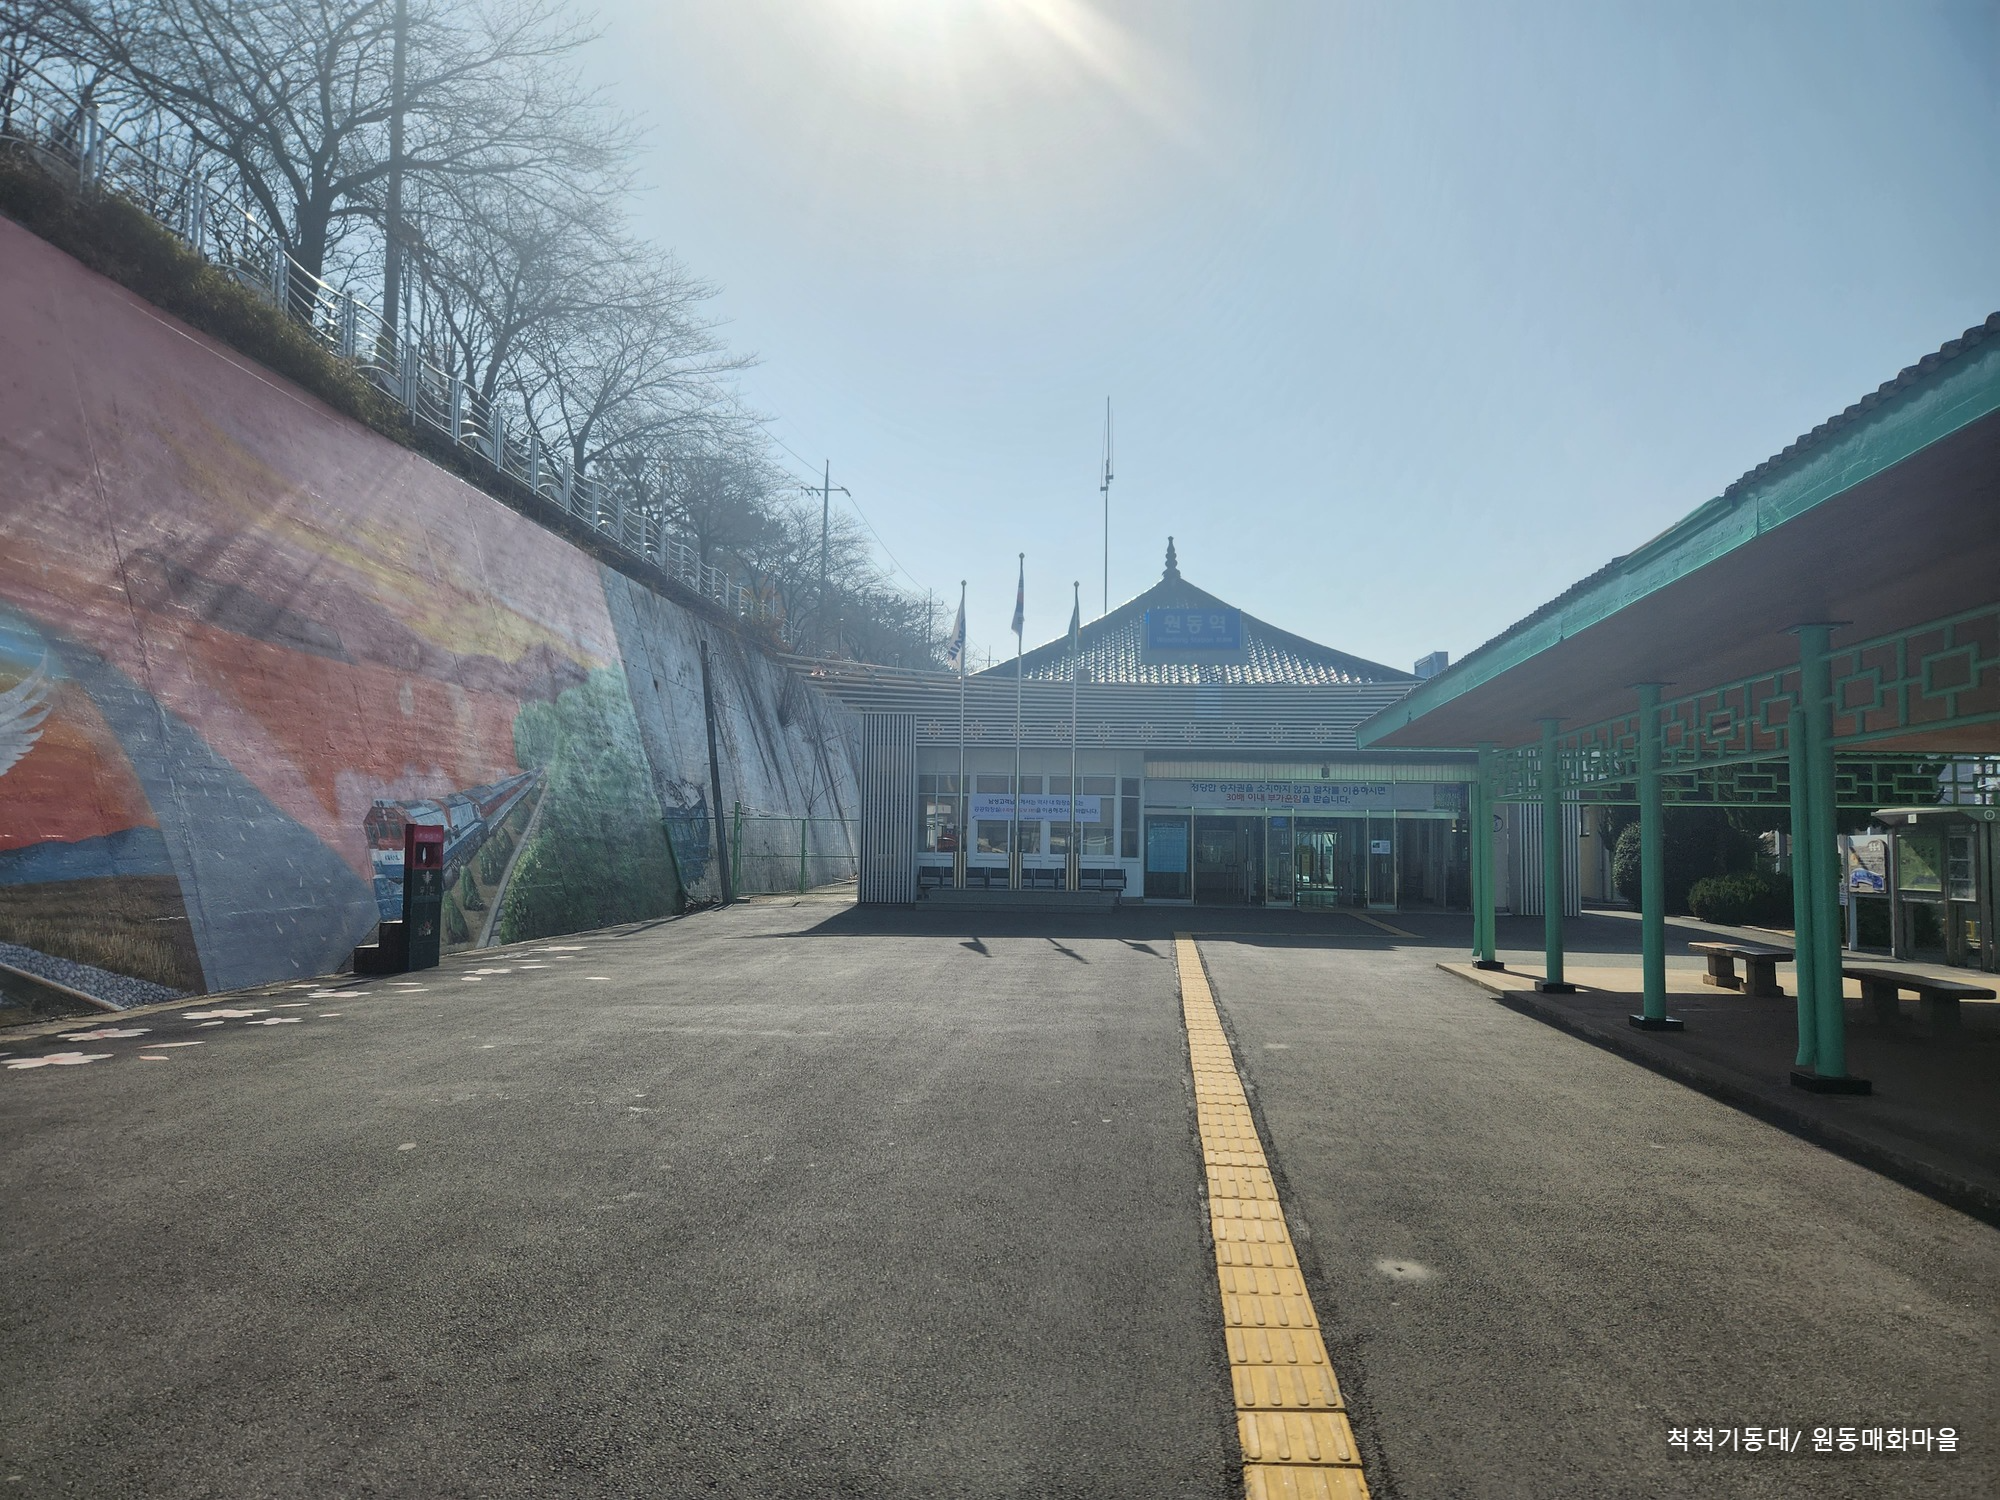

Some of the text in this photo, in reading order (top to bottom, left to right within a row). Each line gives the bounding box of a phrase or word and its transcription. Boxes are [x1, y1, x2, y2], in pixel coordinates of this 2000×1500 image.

[1163, 615, 1226, 634] 원동역
[1219, 784, 1254, 793] 승차권을
[1257, 784, 1291, 793] 소지하지
[1313, 785, 1340, 794] 열차를
[1343, 786, 1386, 795] 이용하시면
[1226, 793, 1351, 804] 30배 이내 부가운임을 받습니다.
